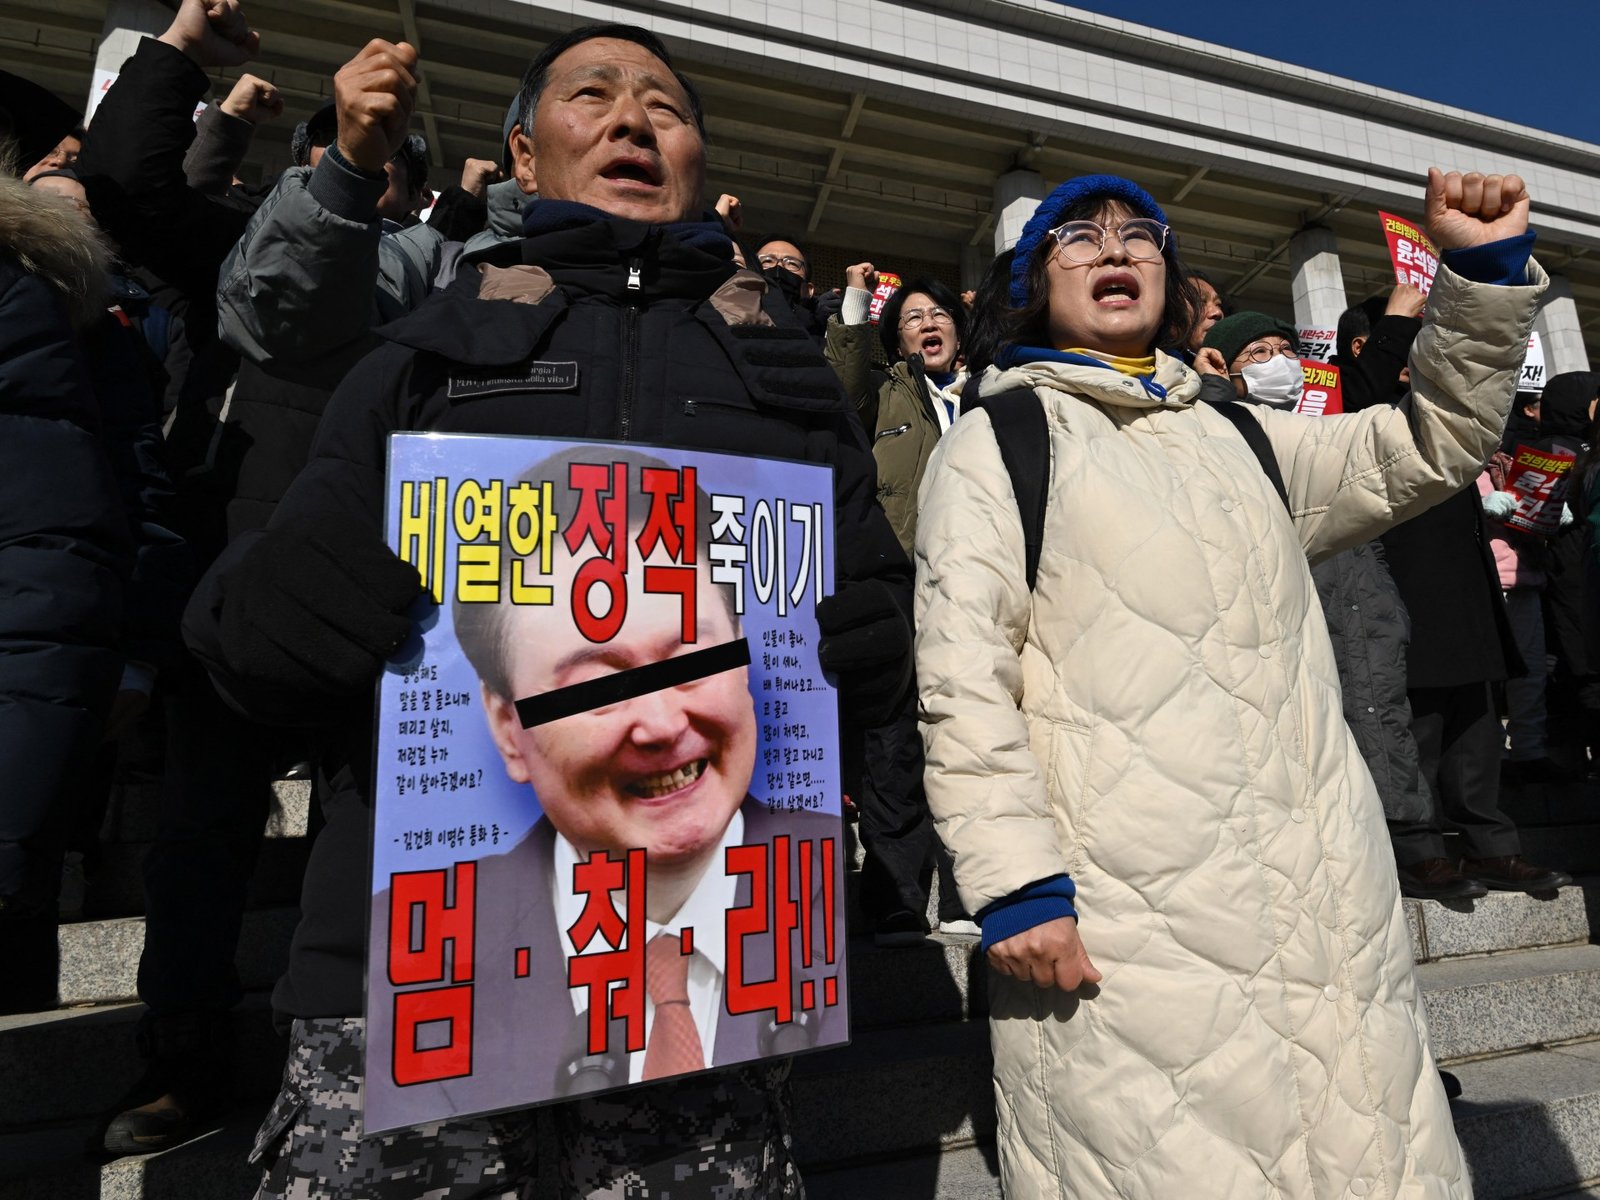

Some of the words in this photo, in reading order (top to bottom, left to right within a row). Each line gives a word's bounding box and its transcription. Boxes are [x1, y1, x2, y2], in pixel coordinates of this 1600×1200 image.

[1299, 329, 1336, 340] 내란수괴
[1301, 366, 1337, 388] 라개입
[398, 476, 559, 606] 비열한
[562, 461, 698, 645] 정적
[708, 493, 823, 617] 죽이기
[763, 630, 786, 647] 인물이
[763, 652, 779, 670] 힘이
[400, 690, 418, 712] 말을
[422, 690, 432, 711] 잘
[436, 689, 471, 711] 들으니까
[763, 724, 780, 742] 많이
[430, 746, 449, 764] 누가
[763, 749, 780, 766] 방귀
[784, 747, 799, 766] 달고
[802, 747, 824, 761] 다니고
[396, 775, 416, 796] 같이
[419, 768, 483, 795] 살아주겠어요?
[767, 772, 783, 790] 당신
[767, 795, 784, 815] 같이
[787, 791, 824, 814] 살겠어요?
[403, 828, 433, 851] 김건희
[438, 826, 465, 848] 이명수
[469, 824, 488, 847] 통화
[491, 823, 500, 845] 중
